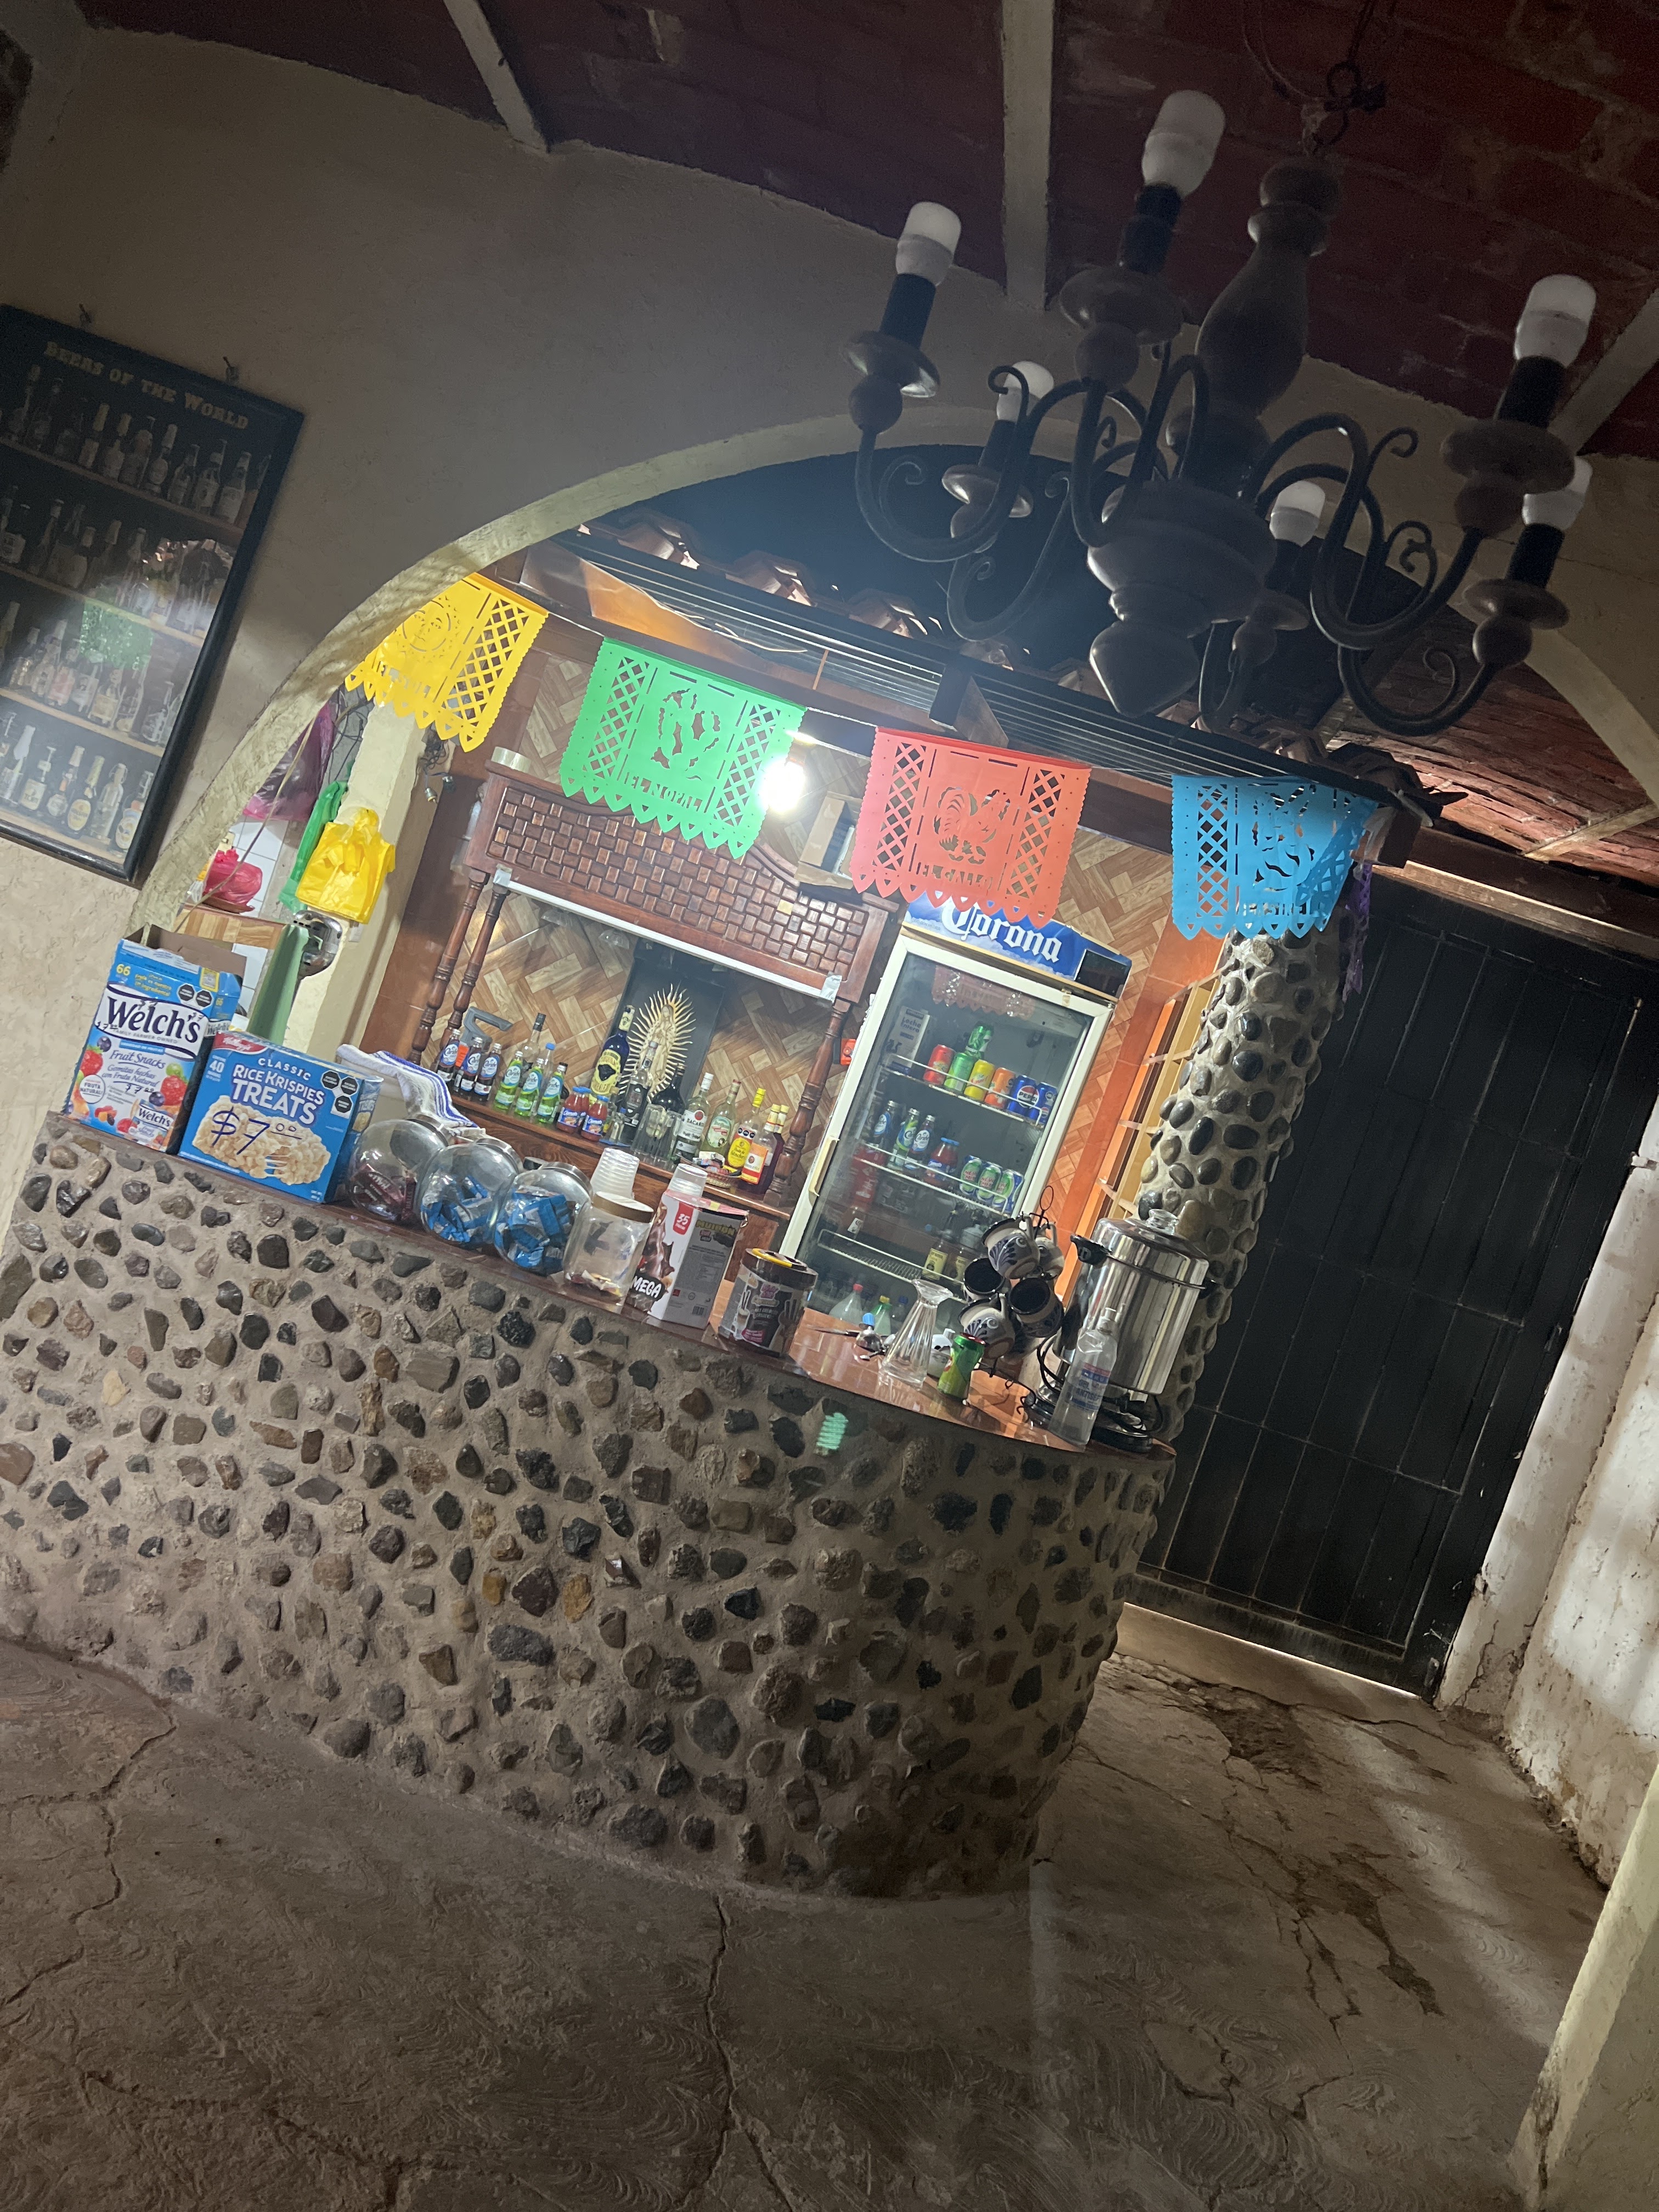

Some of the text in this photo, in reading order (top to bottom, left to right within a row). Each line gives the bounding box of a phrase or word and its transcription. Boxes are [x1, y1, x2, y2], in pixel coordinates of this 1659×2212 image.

[110, 368, 134, 385] OF
[141, 379, 177, 403] THE
[184, 392, 249, 430] WORLD
[626, 773, 698, 812] EL NOPAL
[917, 862, 992, 889] EL GALLO
[941, 900, 1062, 963] Corona
[116, 963, 131, 976] 66
[107, 996, 200, 1043] Welch's
[902, 1017, 922, 1029] Leche
[109, 1049, 165, 1069] Fruit Snacks
[209, 1060, 224, 1073] 40
[258, 1058, 311, 1081] CLASSIC
[113, 1072, 132, 1080] Fruta
[132, 1075, 160, 1087] Natural
[133, 1066, 156, 1079] hechas
[233, 1064, 266, 1082] RICE
[266, 1070, 325, 1106] KRISPIES
[233, 1078, 317, 1125] TREATS
[1019, 1091, 1038, 1103] PEPSI
[138, 1108, 171, 1127] Welch's
[677, 1214, 691, 1226] 35
[633, 1276, 662, 1298] MEGA
